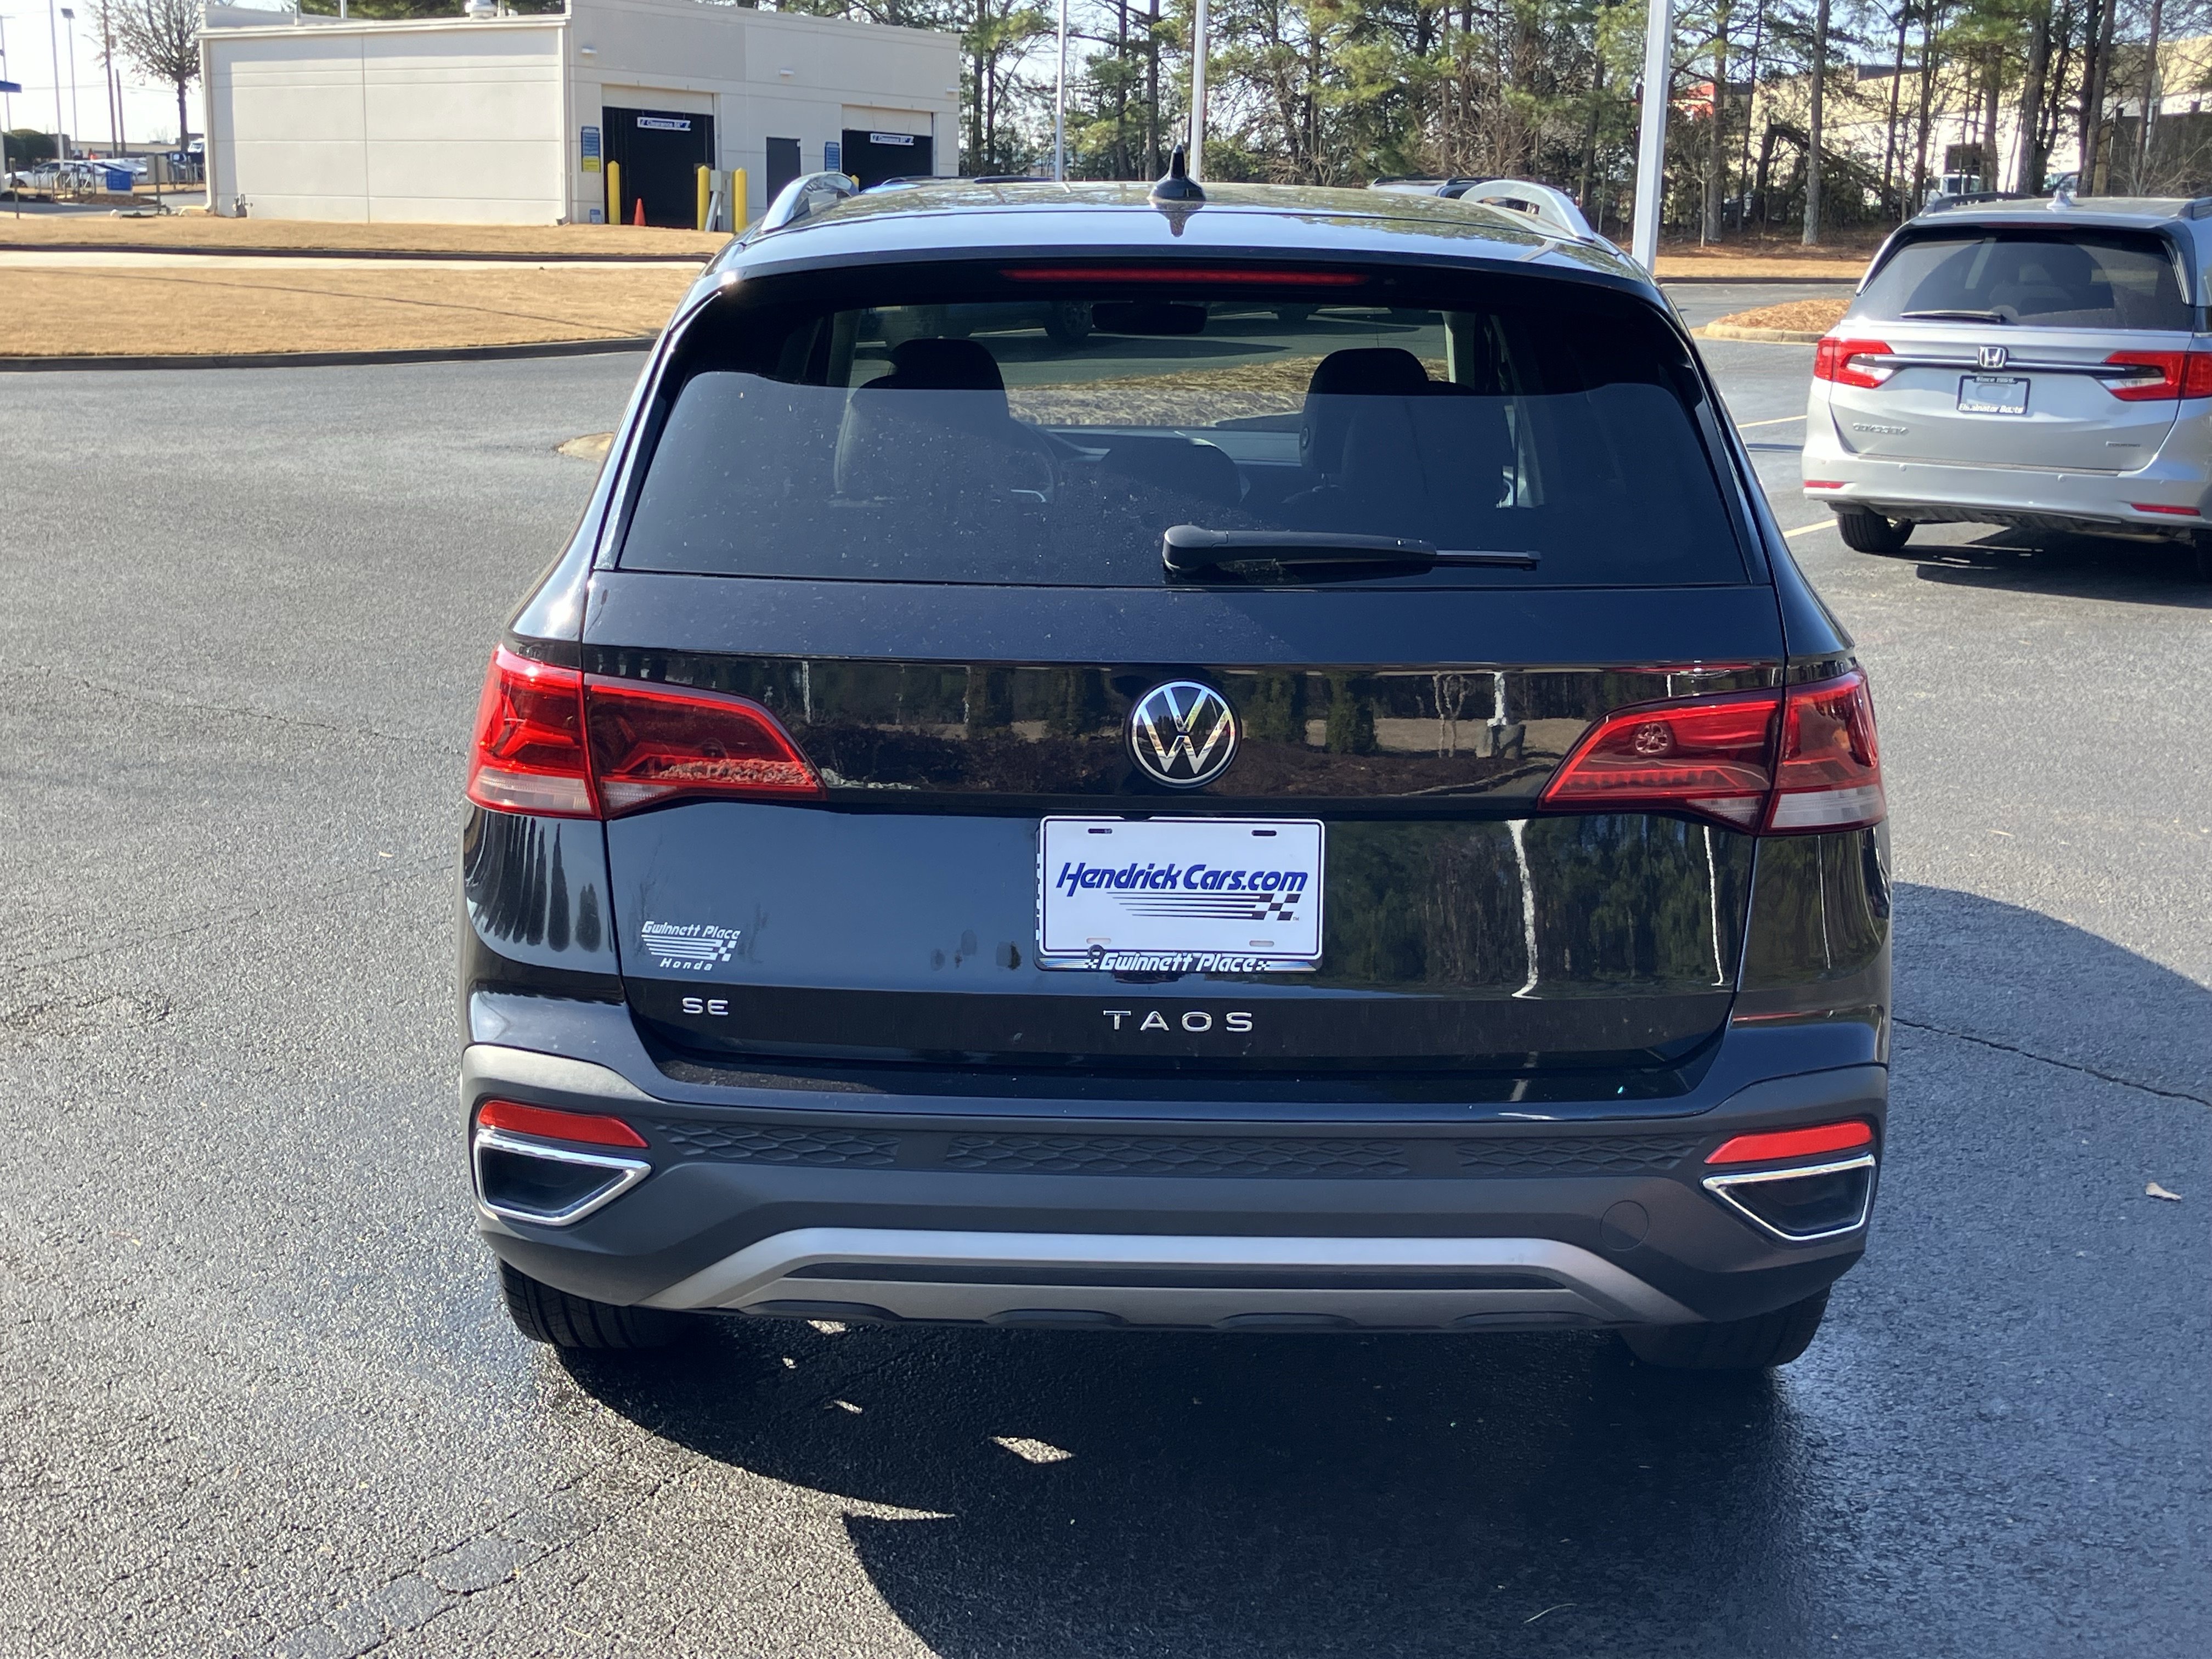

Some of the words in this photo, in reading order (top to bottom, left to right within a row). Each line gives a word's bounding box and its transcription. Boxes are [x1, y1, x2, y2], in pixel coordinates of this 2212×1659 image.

[641, 920, 701, 936] Gwinnett
[702, 925, 741, 940] Place
[659, 957, 713, 971] Honda
[1099, 952, 1193, 972] Gwinnett
[1195, 953, 1258, 973] Place
[682, 997, 729, 1016] SE
[1103, 1010, 1254, 1032] TAOS
